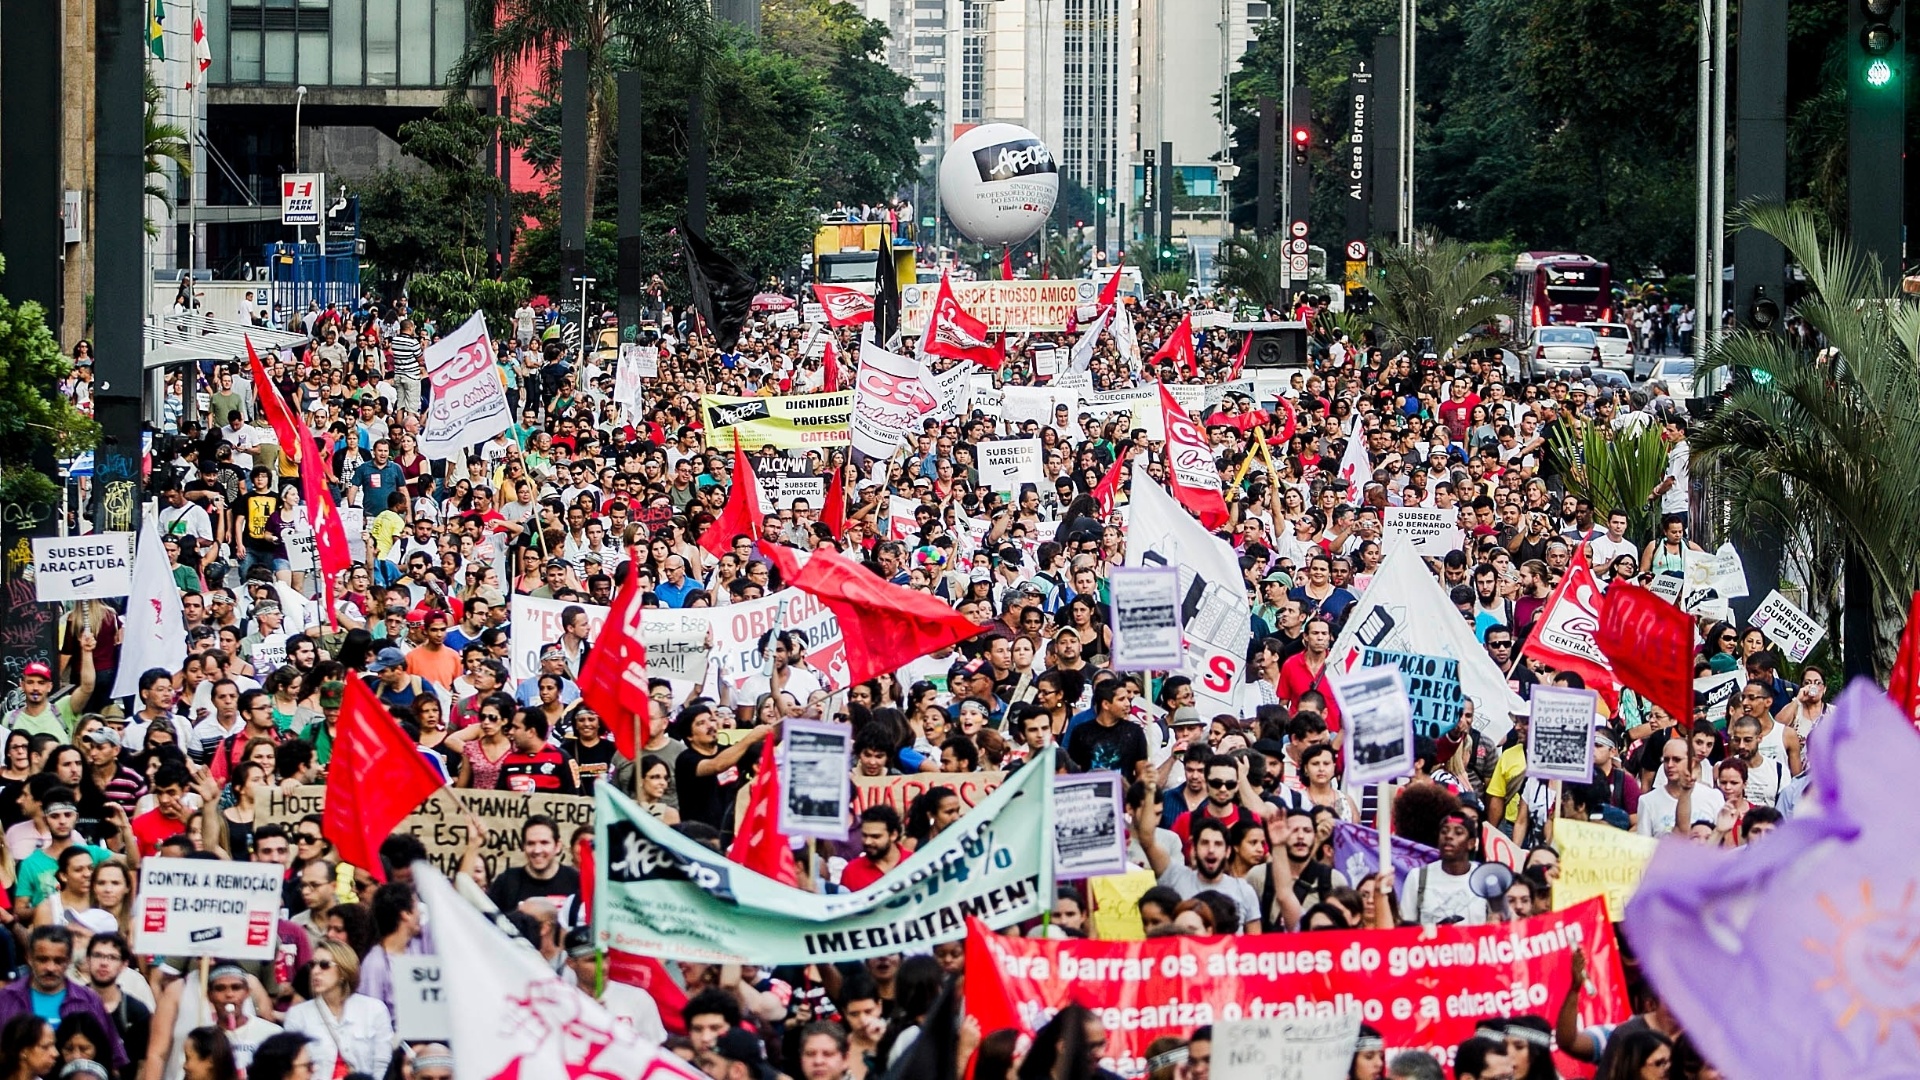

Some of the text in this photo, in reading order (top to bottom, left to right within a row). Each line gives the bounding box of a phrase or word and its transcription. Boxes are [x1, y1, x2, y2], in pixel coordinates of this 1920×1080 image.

[1351, 94, 1365, 200] Al. Casa Branca
[976, 190, 1025, 199] PROFESSORES
[1010, 184, 1043, 192] SINDICATO
[1294, 241, 1305, 249] 60
[1000, 287, 1037, 302] NOSSO
[1041, 286, 1076, 302] AMIGO
[982, 307, 1000, 325] ELE
[1005, 306, 1044, 325] MEXEU
[785, 396, 850, 410] DIGNIDADE
[986, 446, 1034, 457] SUBSEDE
[758, 458, 807, 474] ALCKMIN
[785, 481, 818, 489] SUBSEDE
[1387, 519, 1452, 529] SÃO BERNARDO
[1398, 512, 1442, 521] SUBSEDE
[48, 545, 114, 559] SUBSEDE
[39, 558, 125, 573] ARAÇATUBA
[1764, 605, 1813, 646] OURINHOS
[1772, 599, 1817, 637] SUBSEDE
[1548, 634, 1591, 655] CENTRAL
[1362, 649, 1436, 677] EDUCAÇÃO
[1555, 715, 1585, 725] chão!
[271, 792, 324, 817] HOJE
[458, 793, 530, 819] AMANHÃ
[147, 871, 279, 893] CONTRA A REMOÇÃO
[172, 896, 248, 915] EX-OFFICIO!
[1058, 950, 1155, 982] barrar
[1161, 954, 1198, 978] os
[1208, 950, 1333, 981] ataques
[1340, 942, 1381, 972] do
[1477, 920, 1583, 965] Alckmin
[1098, 996, 1214, 1031] recariza
[1223, 1001, 1243, 1024] o
[1249, 992, 1384, 1023] trabalho
[1391, 999, 1413, 1020] e
[1418, 996, 1441, 1021] a
